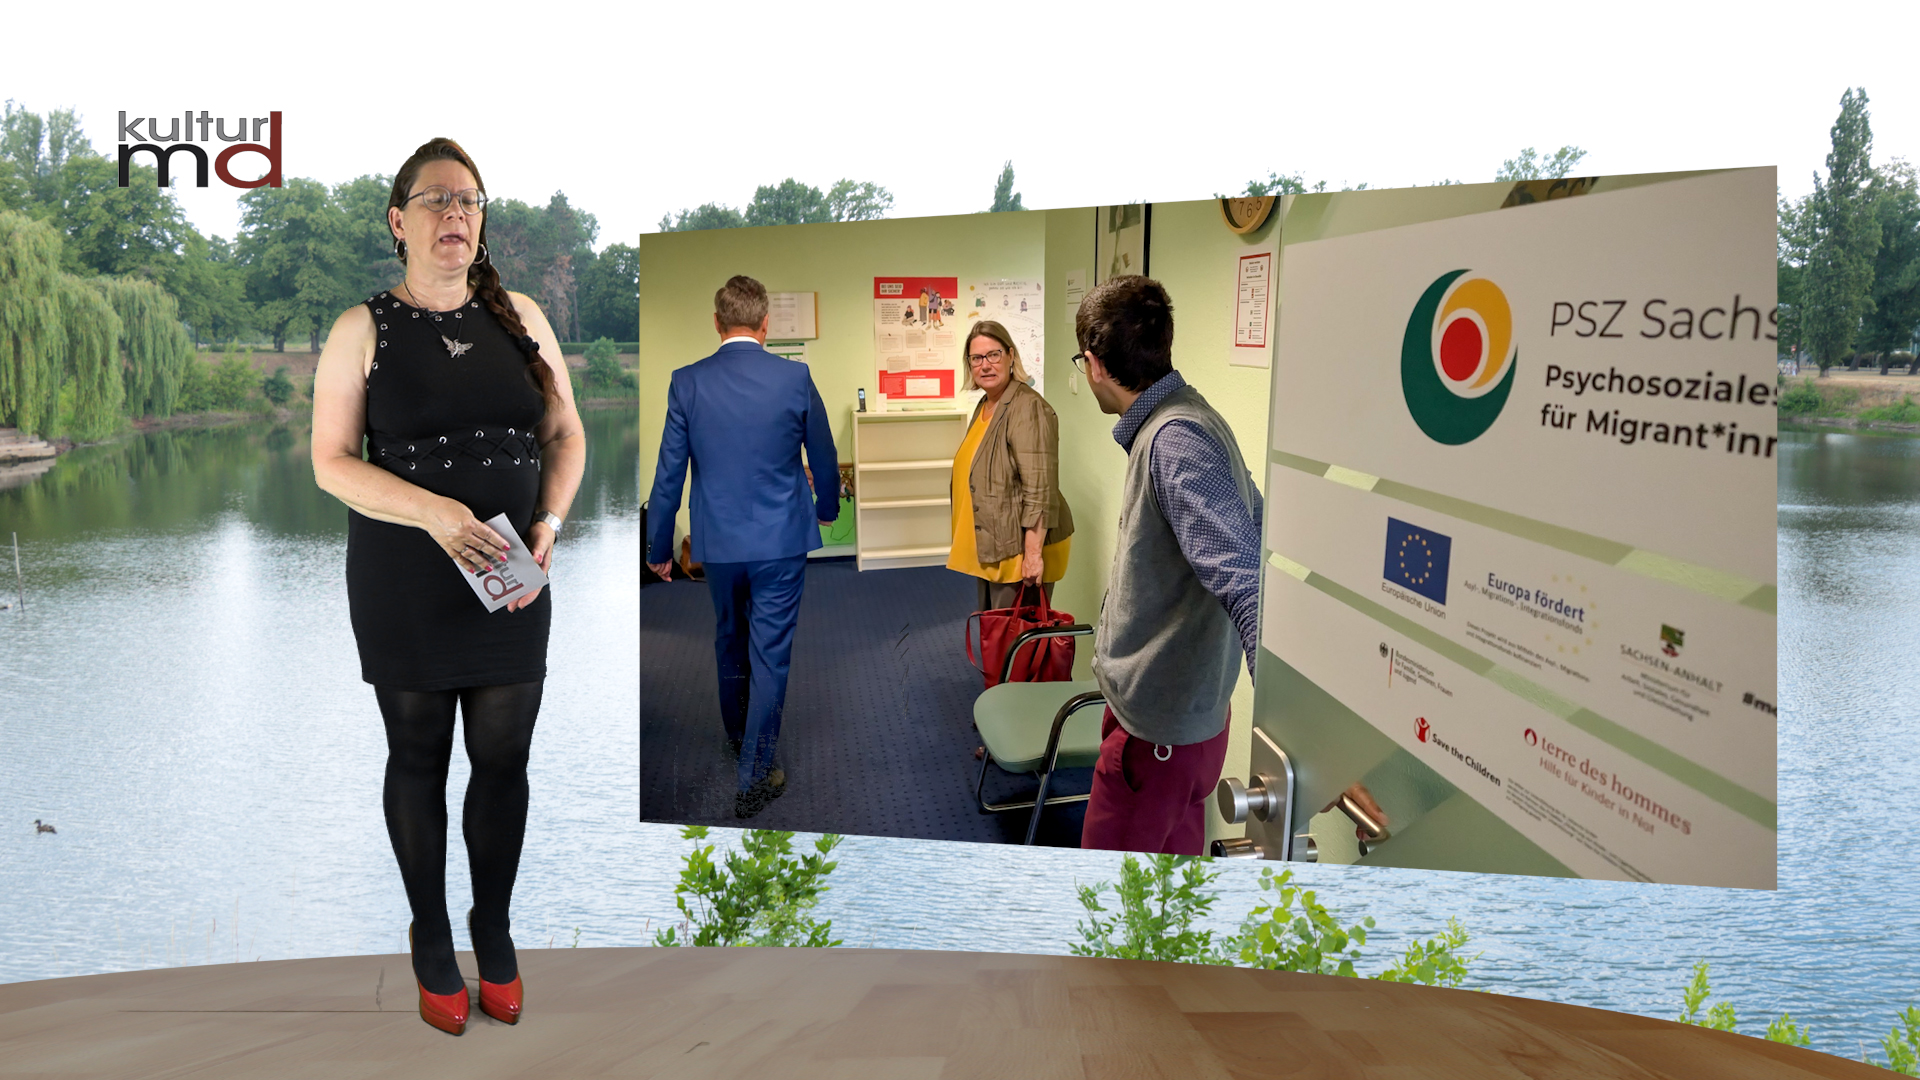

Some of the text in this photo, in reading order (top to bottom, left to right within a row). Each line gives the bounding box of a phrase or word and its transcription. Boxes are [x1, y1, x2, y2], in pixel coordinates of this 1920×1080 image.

[1239, 200, 1245, 216] 7
[1246, 202, 1253, 218] 6
[1256, 196, 1262, 211] 5
[1550, 300, 1627, 338] PSZ
[1541, 403, 1577, 430] für
[1381, 582, 1447, 620] Europäische Union
[1488, 572, 1585, 623] Europa fördert
[1432, 733, 1501, 787] Save the Children
[1539, 757, 1656, 835] Hilfe für Kinder in Not
[1541, 737, 1692, 835] terre des hommes
